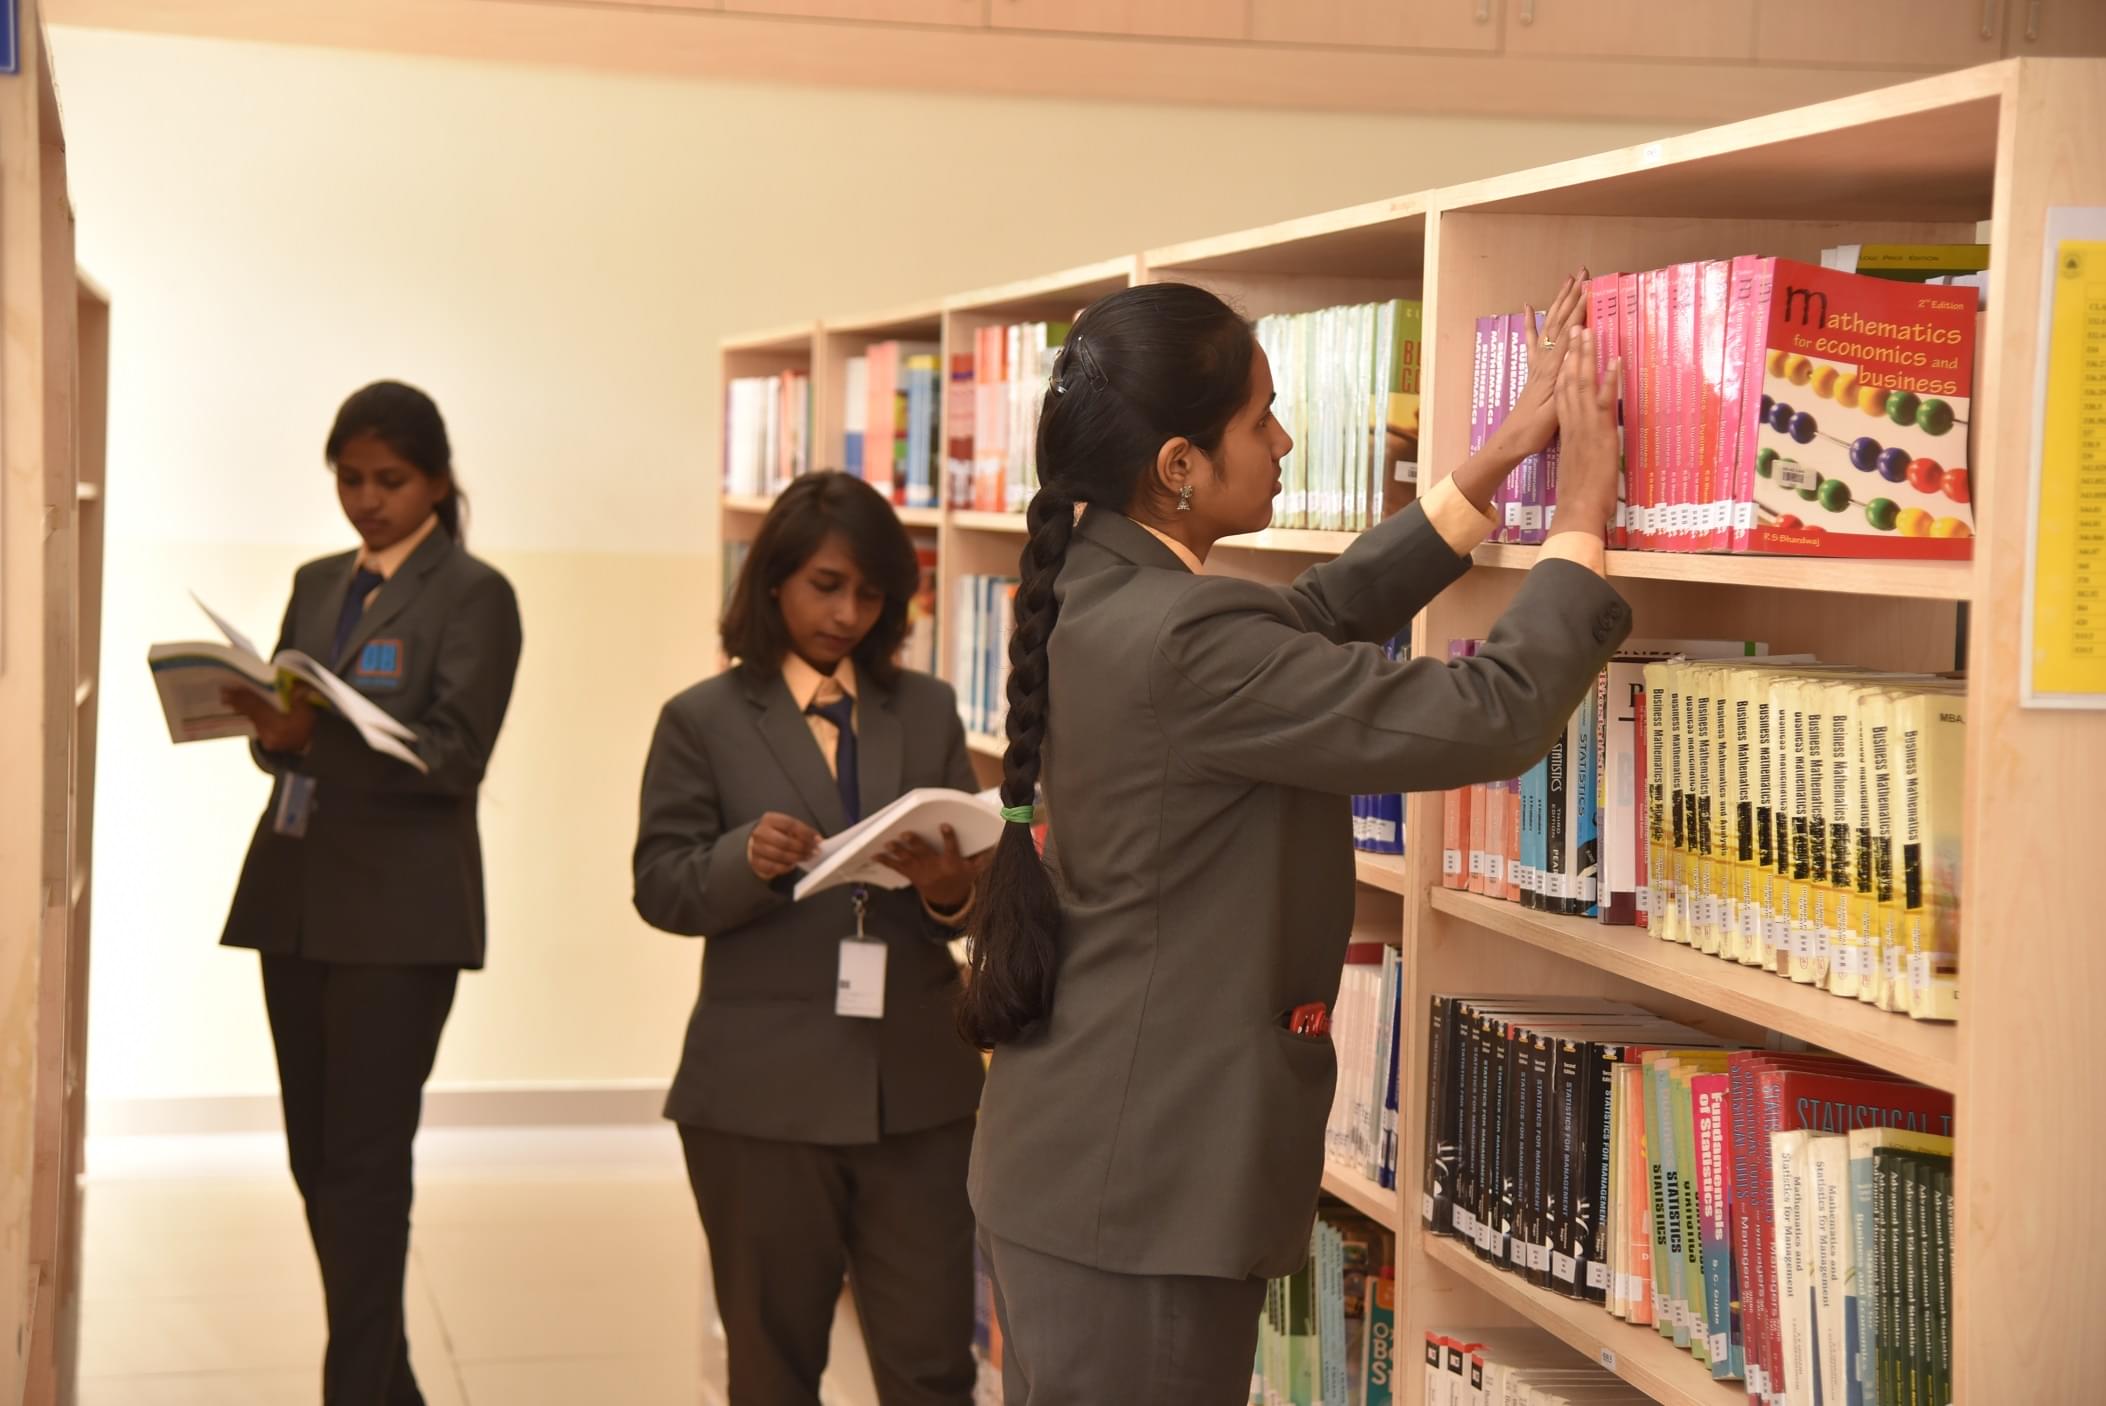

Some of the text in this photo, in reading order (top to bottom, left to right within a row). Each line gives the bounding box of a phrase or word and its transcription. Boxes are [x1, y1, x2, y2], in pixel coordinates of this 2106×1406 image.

[1931, 300, 1964, 311] Edition
[1472, 332, 1482, 424] MATHEMATICS
[1479, 344, 1488, 408] BUSINESS
[1487, 331, 1497, 424] MATHEMATICS
[1794, 334, 1958, 369] for economics and
[1858, 367, 1958, 395] business
[1653, 689, 1664, 726] Business
[1717, 700, 1726, 739] Business
[1578, 734, 1588, 816] STATISTICS
[1654, 730, 1665, 783] Mathematics
[1672, 734, 1681, 788] Mathematics
[1698, 698, 1711, 795] Business Mathematics
[1719, 742, 1728, 798] Mathematics
[1736, 701, 1751, 800] Business Mathematics
[1759, 704, 1771, 804] Business Mathematics
[1808, 715, 1824, 818] Business Mathematics
[1833, 716, 1848, 821] Business Mathematics
[1720, 801, 1728, 816] and
[1795, 756, 1806, 814] Mathematics
[1872, 726, 1891, 835] Business Mathematics
[1905, 731, 1919, 840] Business Mathematics
[1564, 1082, 1572, 1130] STATISTICS
[1603, 1090, 1611, 1139] STATISTICS
[1562, 1154, 1571, 1217] MANAGEMENT
[1699, 1094, 1713, 1217] of Statistics
[1712, 1092, 1724, 1240] Fundamentals
[1599, 1163, 1608, 1226] MANAGEMENT
[1653, 1165, 1667, 1245] STATISTICS
[1667, 1171, 1682, 1253] STATISTICS
[1782, 1153, 1795, 1297] Statistics for Management
[1793, 1177, 1803, 1272] Mathematics and
[1890, 1172, 1898, 1224] Advanced
[1905, 1180, 1914, 1233] Advanced
[1919, 1184, 1927, 1237] Advanced
[1934, 1191, 1944, 1244] Advanced
[1741, 1216, 1751, 1289] Managers
[1816, 1161, 1830, 1307] Statistics for Management
[1828, 1185, 1838, 1281] Mathematics and
[1855, 1213, 1865, 1268] Business
[1892, 1228, 1900, 1293] Educational
[1857, 1271, 1866, 1296] and
[1907, 1237, 1915, 1302] Educational
[1921, 1241, 1930, 1307] Educational
[1937, 1248, 1946, 1314] Educational
